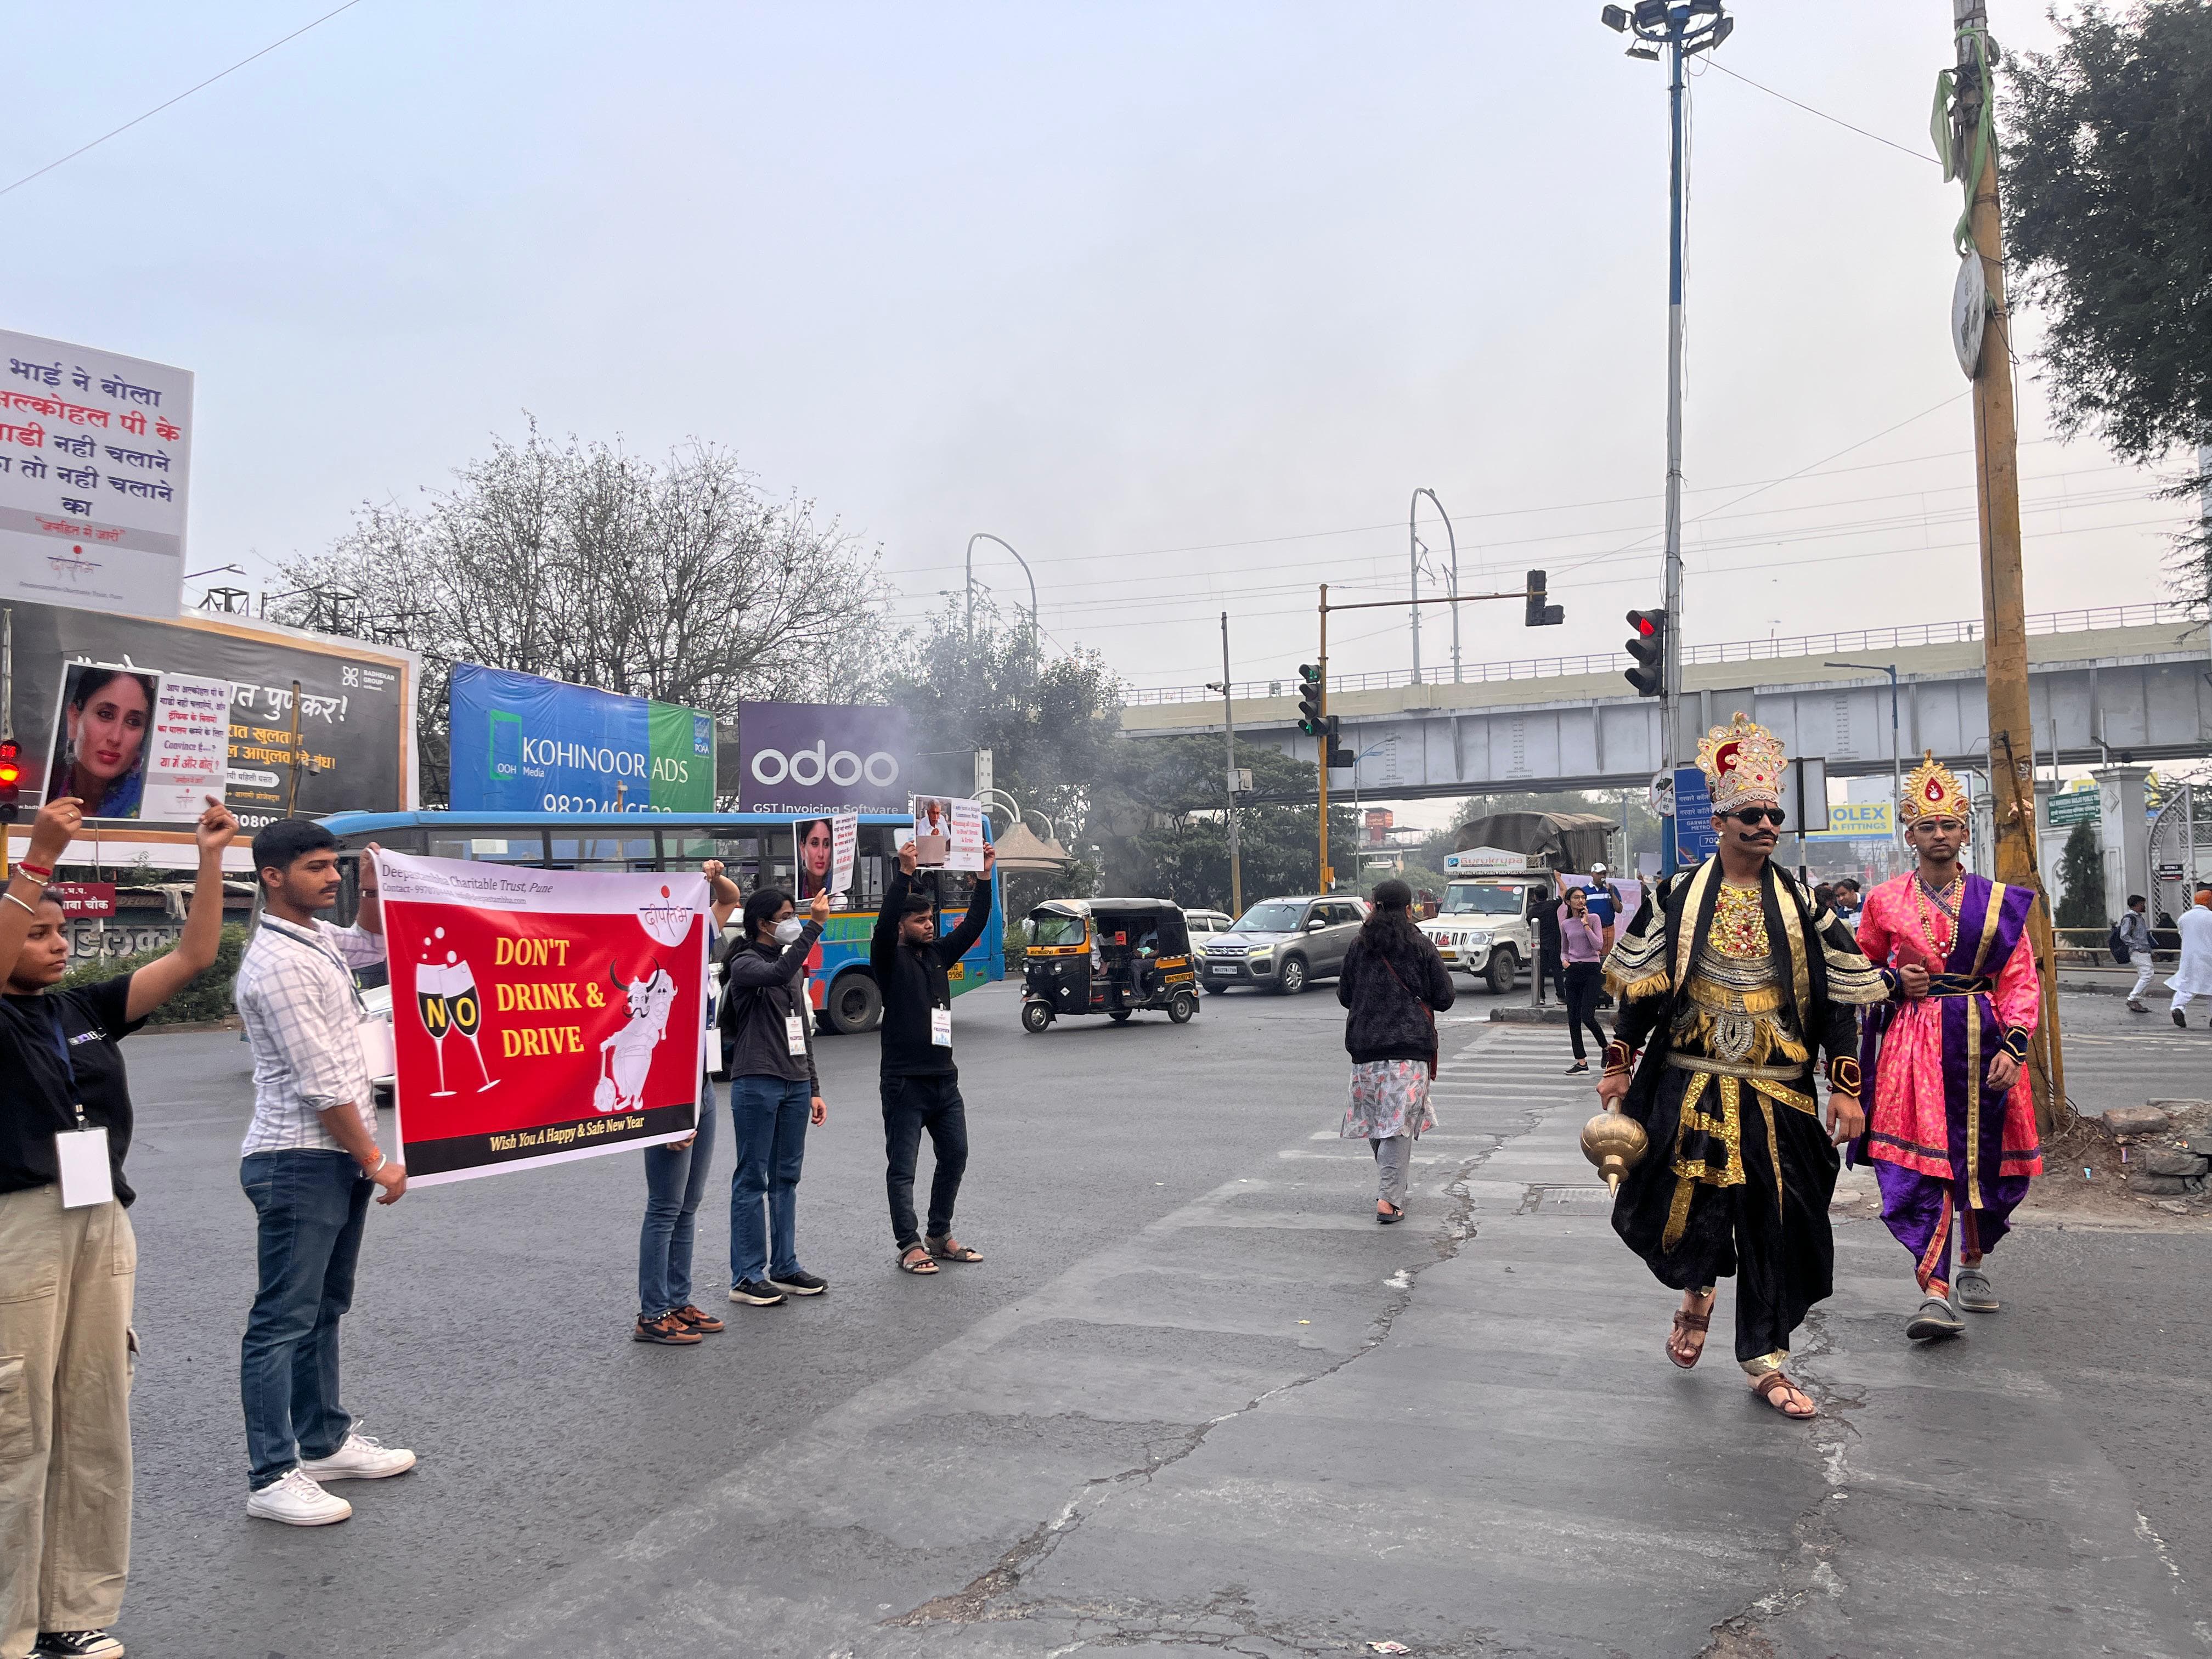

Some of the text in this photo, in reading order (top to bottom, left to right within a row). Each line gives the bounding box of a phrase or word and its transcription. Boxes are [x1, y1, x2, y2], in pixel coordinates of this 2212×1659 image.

[9, 358, 161, 407] भाई ने बोला
[119, 410, 147, 436] पी
[156, 416, 181, 441] के
[54, 435, 97, 458] नही
[105, 445, 171, 472] चलाने
[20, 455, 48, 479] तो
[57, 465, 100, 489] नही
[107, 476, 174, 503] चलाने
[61, 496, 93, 517] का
[363, 669, 395, 681] BADHEKAR
[363, 676, 383, 685] GROUP
[164, 740, 196, 751] Convince
[498, 763, 545, 777] OOH Media
[523, 737, 689, 783] KOHINOOR ADS
[751, 739, 899, 787] odoo
[753, 803, 899, 814] GST Invoicing Software
[1679, 793, 1709, 803] गरवारे कॉले
[1680, 808, 1695, 816] गरवारे
[1830, 807, 1886, 821] OLEX
[450, 876, 498, 890] Charitable
[500, 879, 527, 893] Trust,
[529, 882, 554, 893] Pune
[85, 896, 109, 910] चौक
[495, 936, 569, 967] DON'T
[496, 981, 606, 1012] DRINK &
[427, 998, 477, 1028] NO
[503, 1026, 585, 1058] DRIVE
[489, 1115, 645, 1152] Wish You A Happy & Safe New Year
